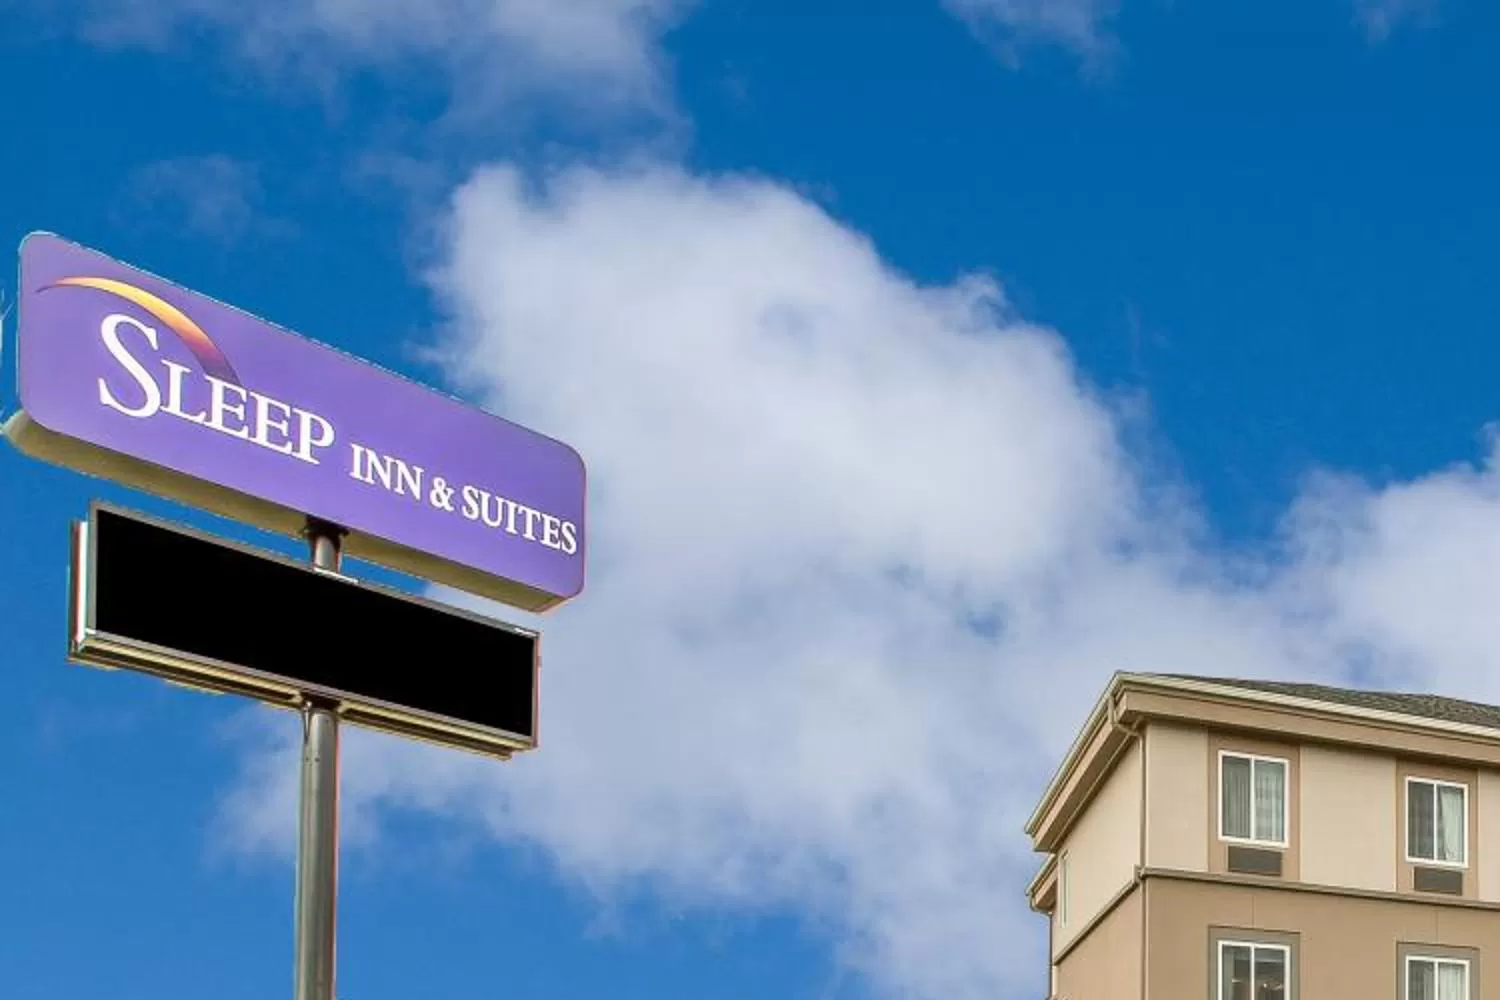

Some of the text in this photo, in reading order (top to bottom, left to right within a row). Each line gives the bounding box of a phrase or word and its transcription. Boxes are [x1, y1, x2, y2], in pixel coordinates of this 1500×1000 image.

[98, 313, 577, 555] SLEEP INN & SUITES
